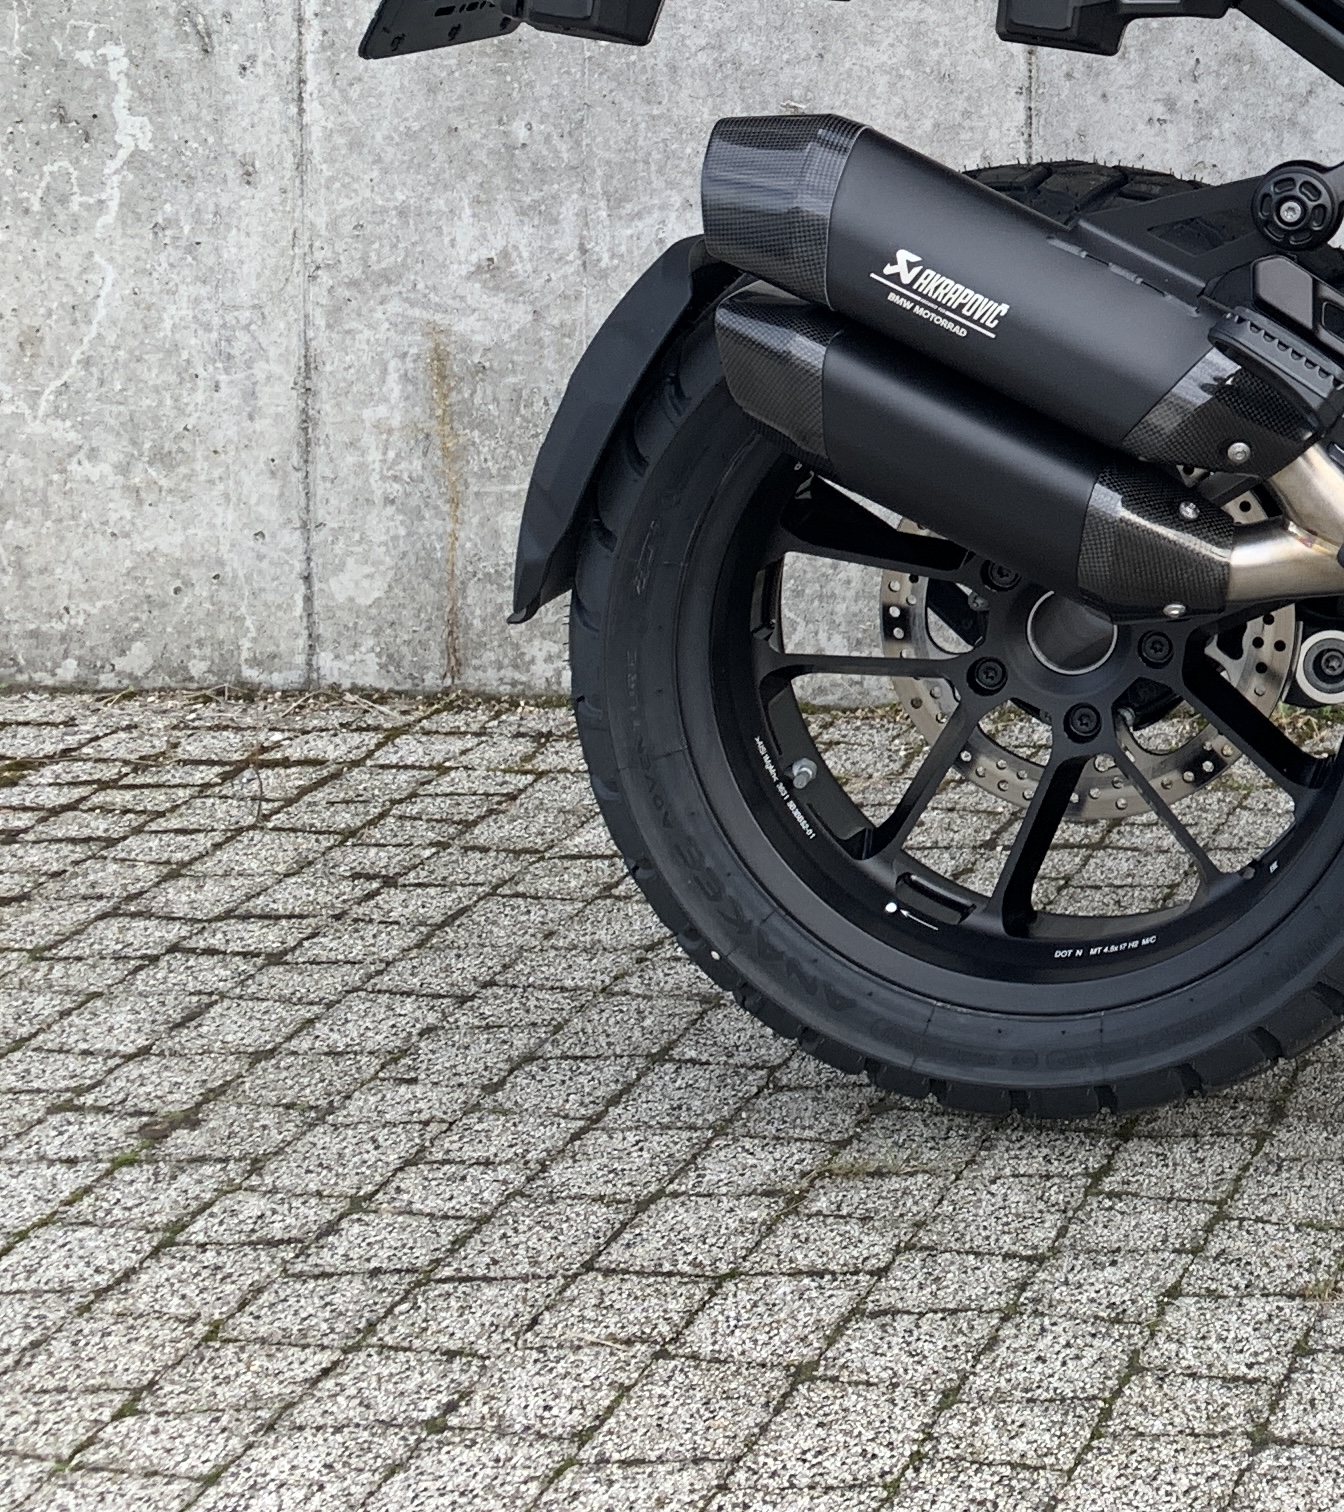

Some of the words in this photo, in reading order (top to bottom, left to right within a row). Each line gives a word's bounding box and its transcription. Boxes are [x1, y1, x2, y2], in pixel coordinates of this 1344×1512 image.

[887, 292, 914, 310] BMW
[913, 305, 968, 337] MOTORRAD
[912, 268, 1010, 329] AKRAPOVIČ
[676, 835, 859, 1015] ANAKEE
